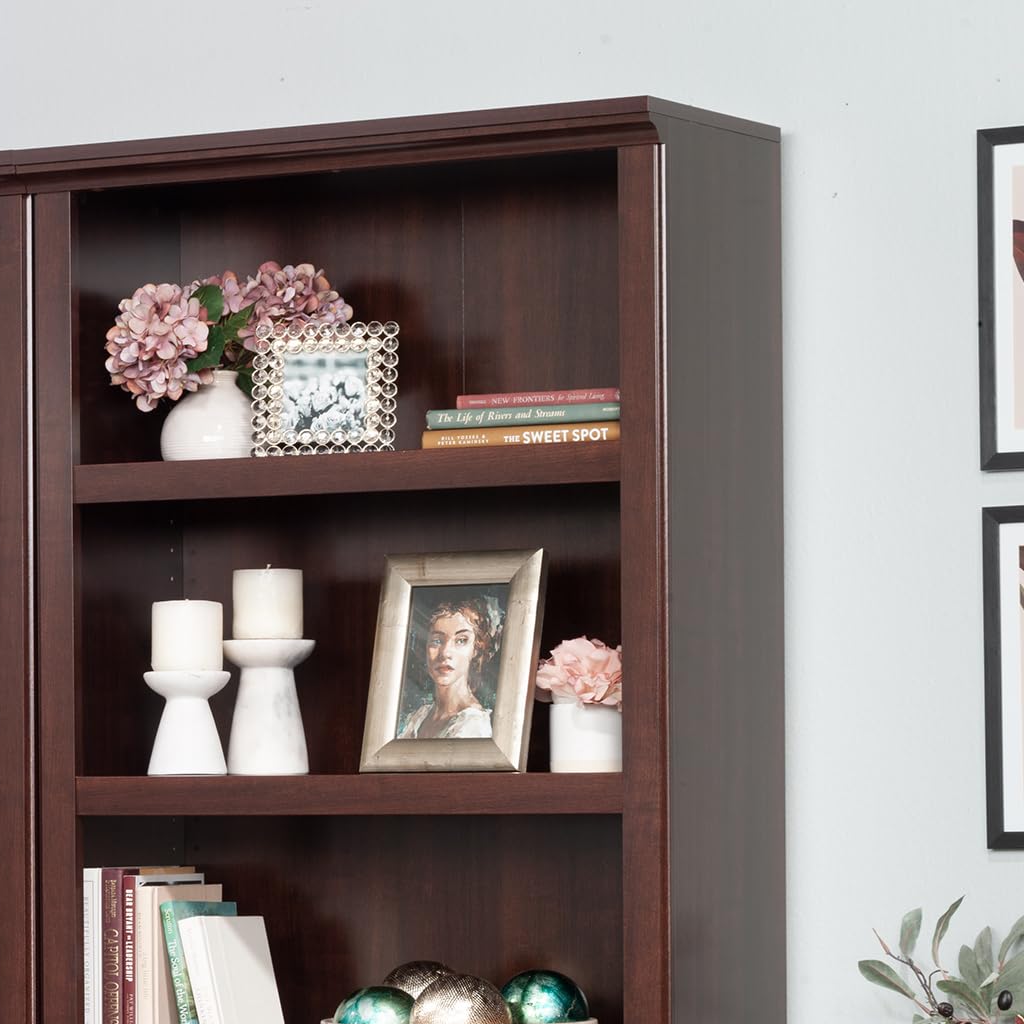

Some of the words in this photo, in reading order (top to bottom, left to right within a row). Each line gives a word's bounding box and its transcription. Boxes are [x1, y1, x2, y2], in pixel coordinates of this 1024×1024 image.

[491, 396, 510, 405] NEW
[513, 393, 555, 404] FRONTIERS
[437, 413, 453, 423] The
[456, 412, 474, 423] Life
[475, 411, 485, 424] of
[487, 410, 512, 421] Rivers
[515, 409, 532, 419] and
[534, 408, 566, 418] Streams
[503, 435, 520, 443] THE
[522, 429, 569, 444] SWEET
[572, 428, 609, 442] SPOT
[125, 889, 133, 906] BEAR
[125, 907, 133, 934] BRYANT
[104, 928, 119, 977] CAPITOL
[167, 939, 177, 954] The
[170, 957, 182, 976] Soul
[174, 978, 183, 988] of
[176, 988, 186, 1003] the
